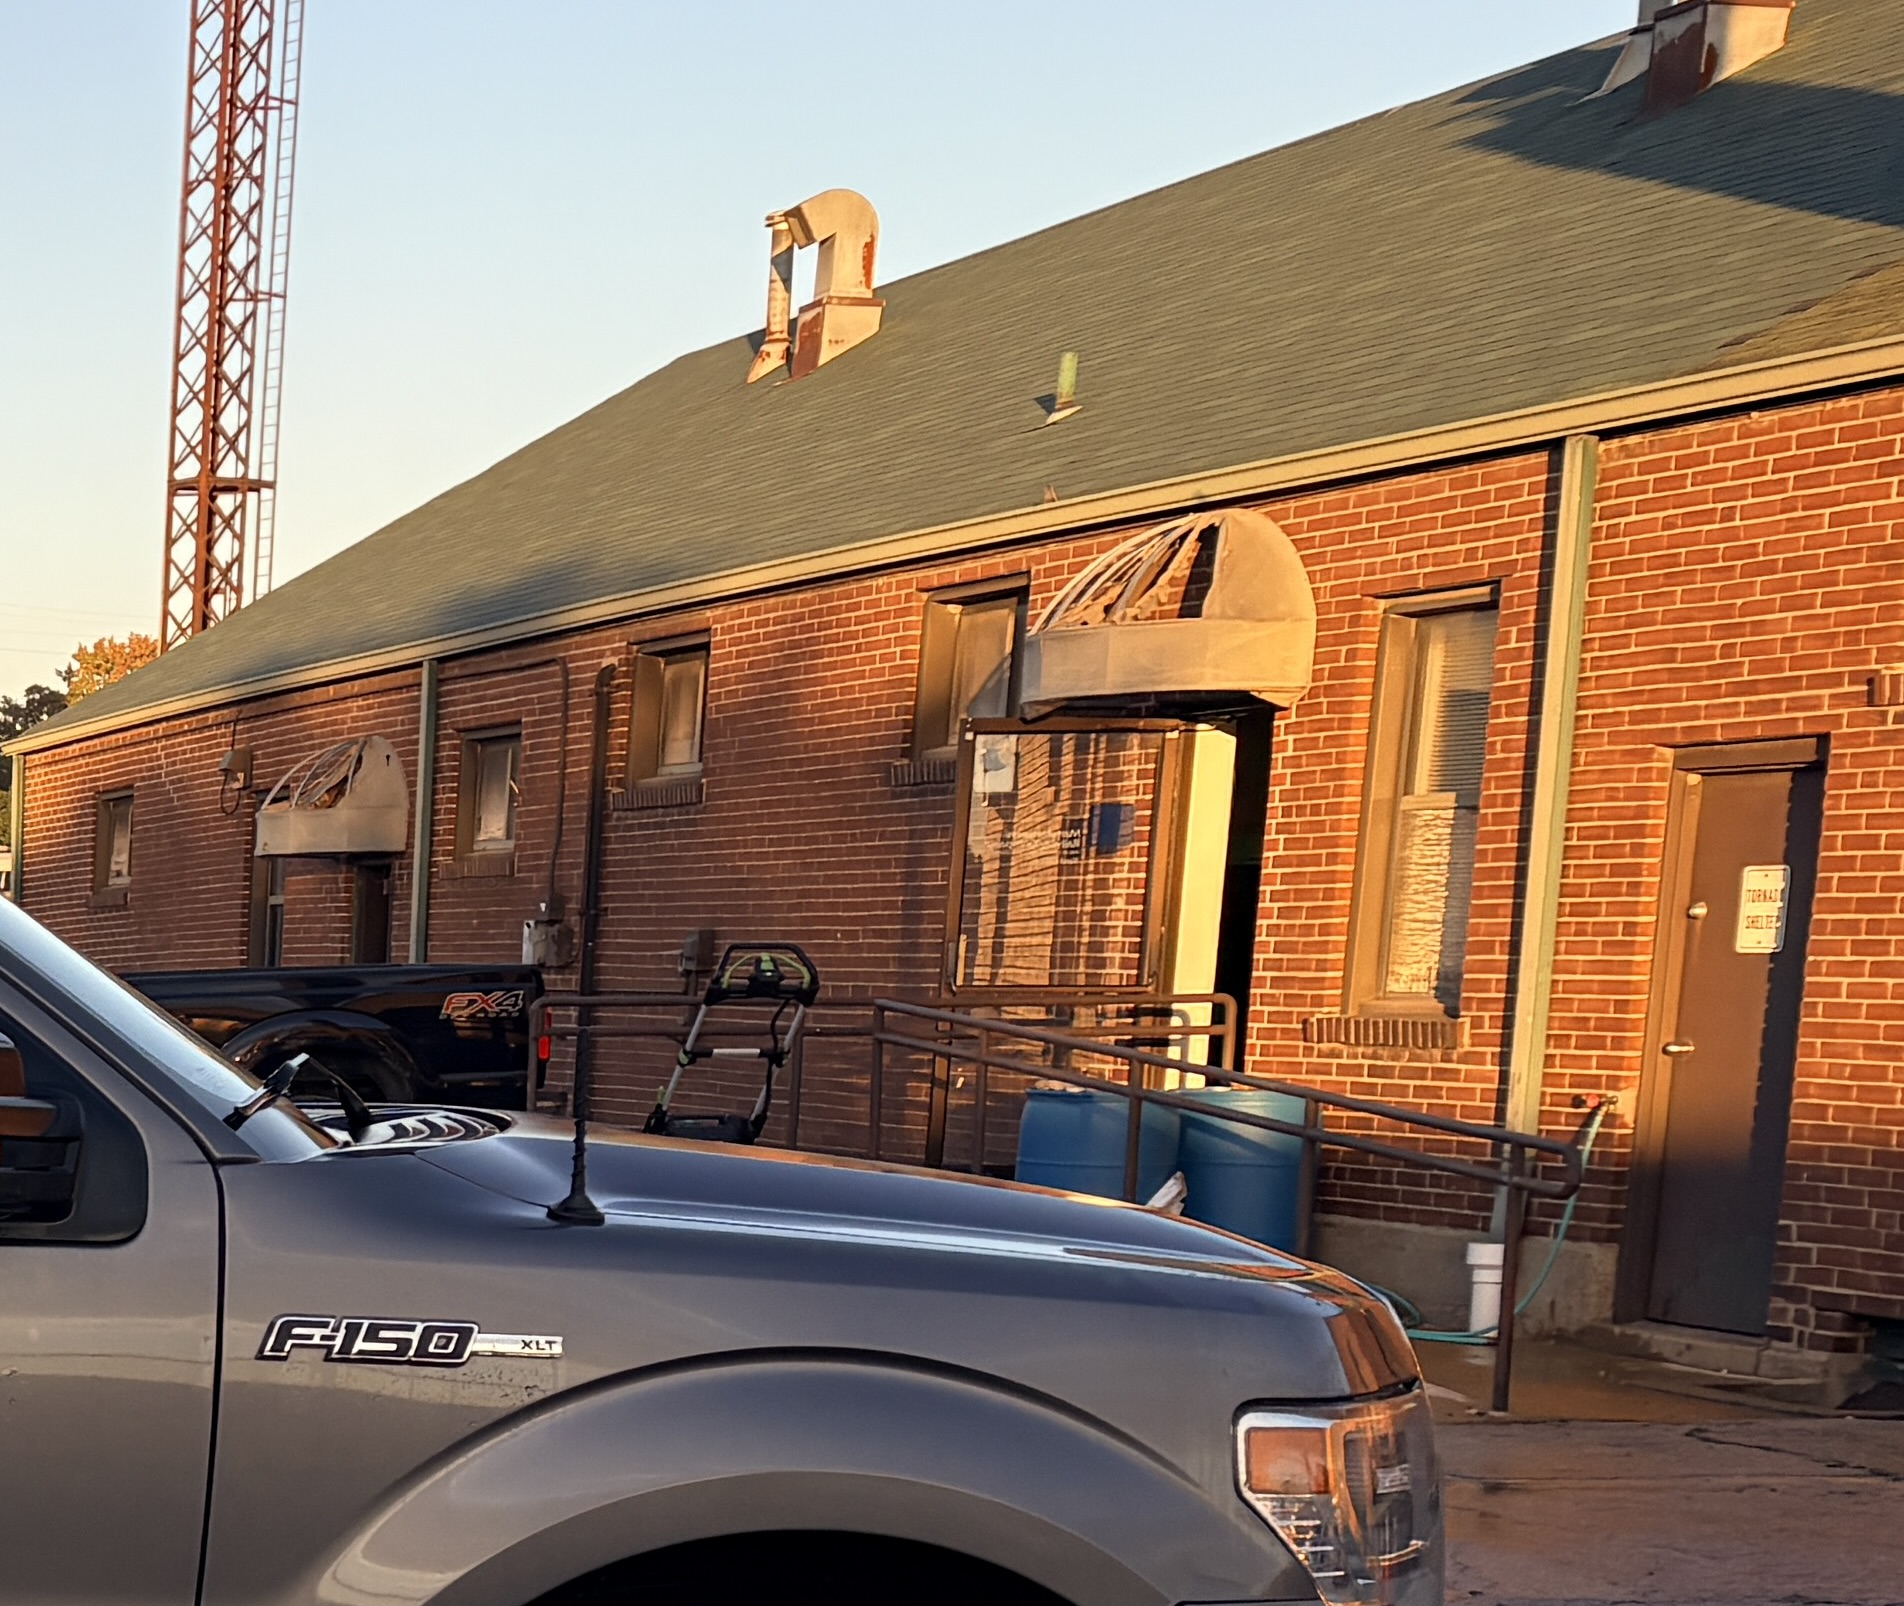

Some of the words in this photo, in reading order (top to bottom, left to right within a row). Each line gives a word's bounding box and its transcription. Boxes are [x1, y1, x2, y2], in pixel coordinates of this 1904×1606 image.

[442, 990, 524, 1015] FX4
[255, 1313, 479, 1367] F-150
[520, 1338, 558, 1351] XLT
